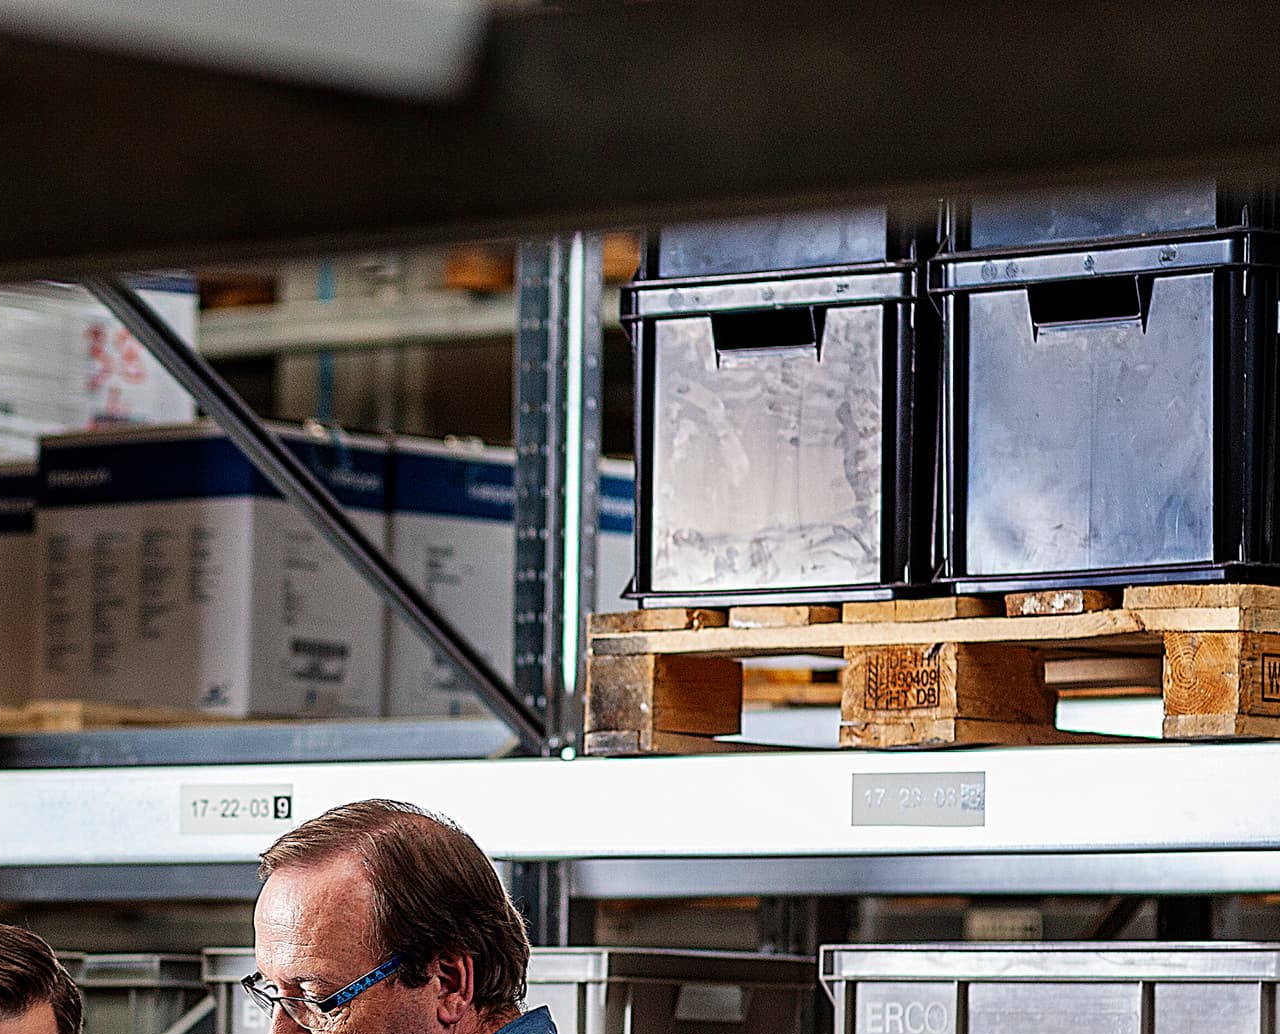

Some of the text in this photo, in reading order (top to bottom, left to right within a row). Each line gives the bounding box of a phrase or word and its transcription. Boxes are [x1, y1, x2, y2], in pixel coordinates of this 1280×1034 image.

[192, 796, 291, 818] 17-22-03 9
[866, 1001, 948, 1034] ERCO
